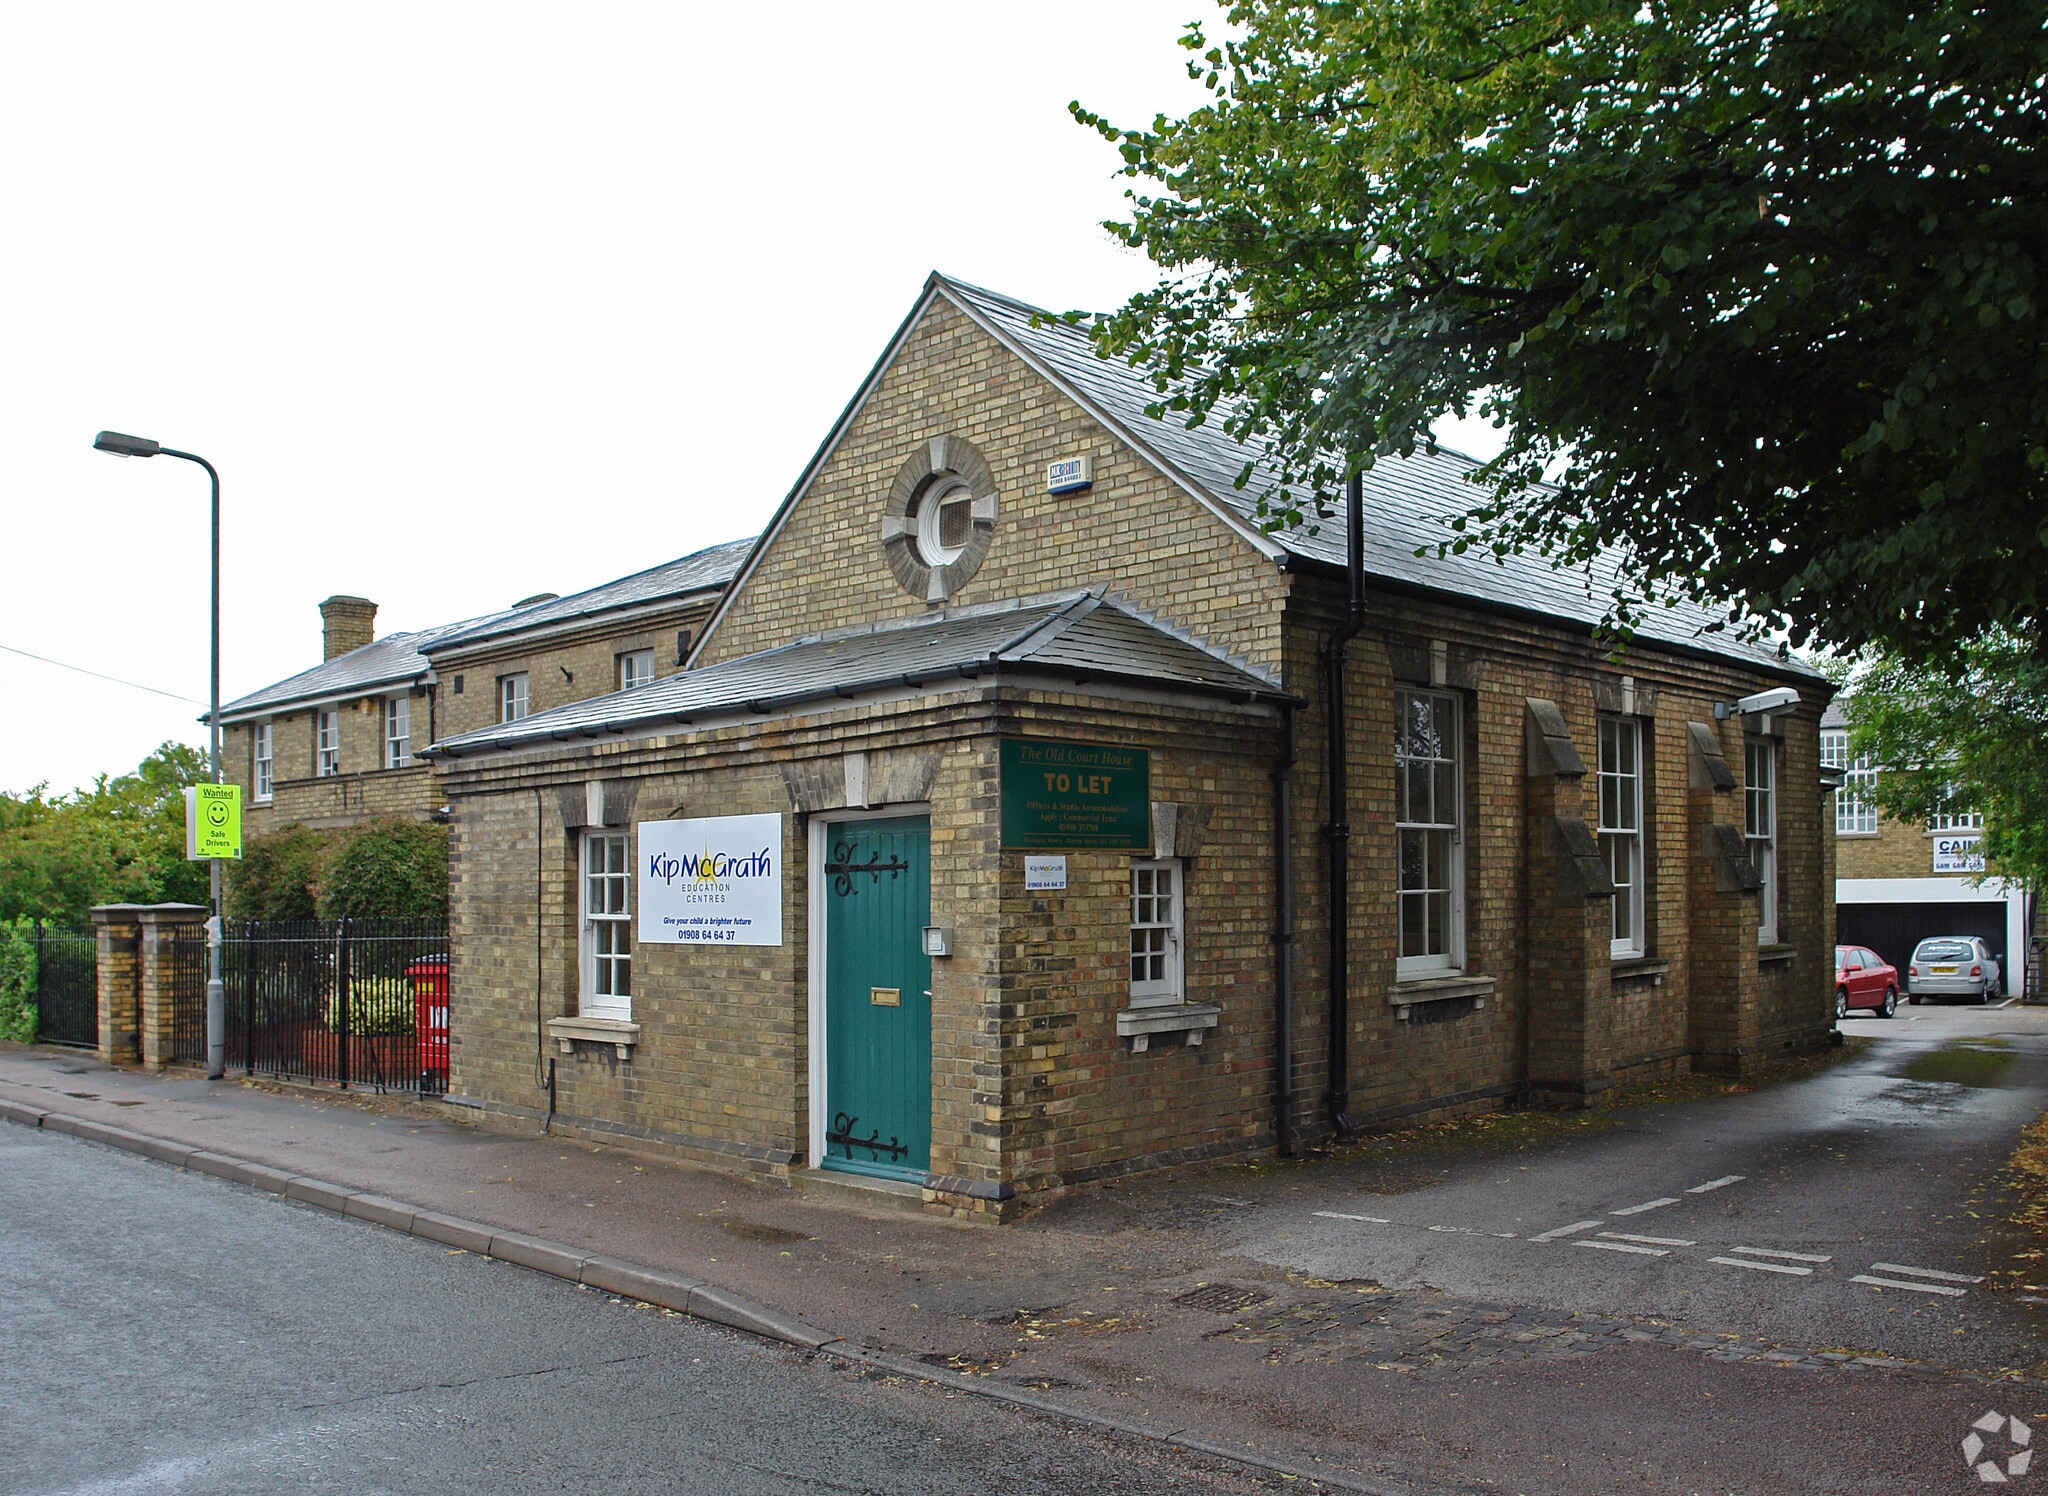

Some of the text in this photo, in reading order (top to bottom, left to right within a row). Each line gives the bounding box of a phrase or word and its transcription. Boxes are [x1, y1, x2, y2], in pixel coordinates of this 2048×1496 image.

[1020, 745, 1133, 765] The Old Court House
[1044, 772, 1112, 795] TO LET
[203, 788, 234, 798] Wanted
[1026, 801, 1050, 810] Offices
[1051, 802, 1058, 811] &
[1040, 813, 1057, 822] Apply
[1063, 813, 1100, 822] Commercial
[210, 830, 226, 838] Safe
[205, 839, 231, 847] Drivers
[681, 883, 731, 893] EDUCATION
[686, 895, 726, 903] CENTRES
[663, 916, 676, 925] Give
[676, 917, 689, 926] your
[689, 916, 703, 925] child
[709, 916, 733, 926] brighter
[733, 916, 752, 926] future
[678, 929, 735, 940] 01908 64 64 37
